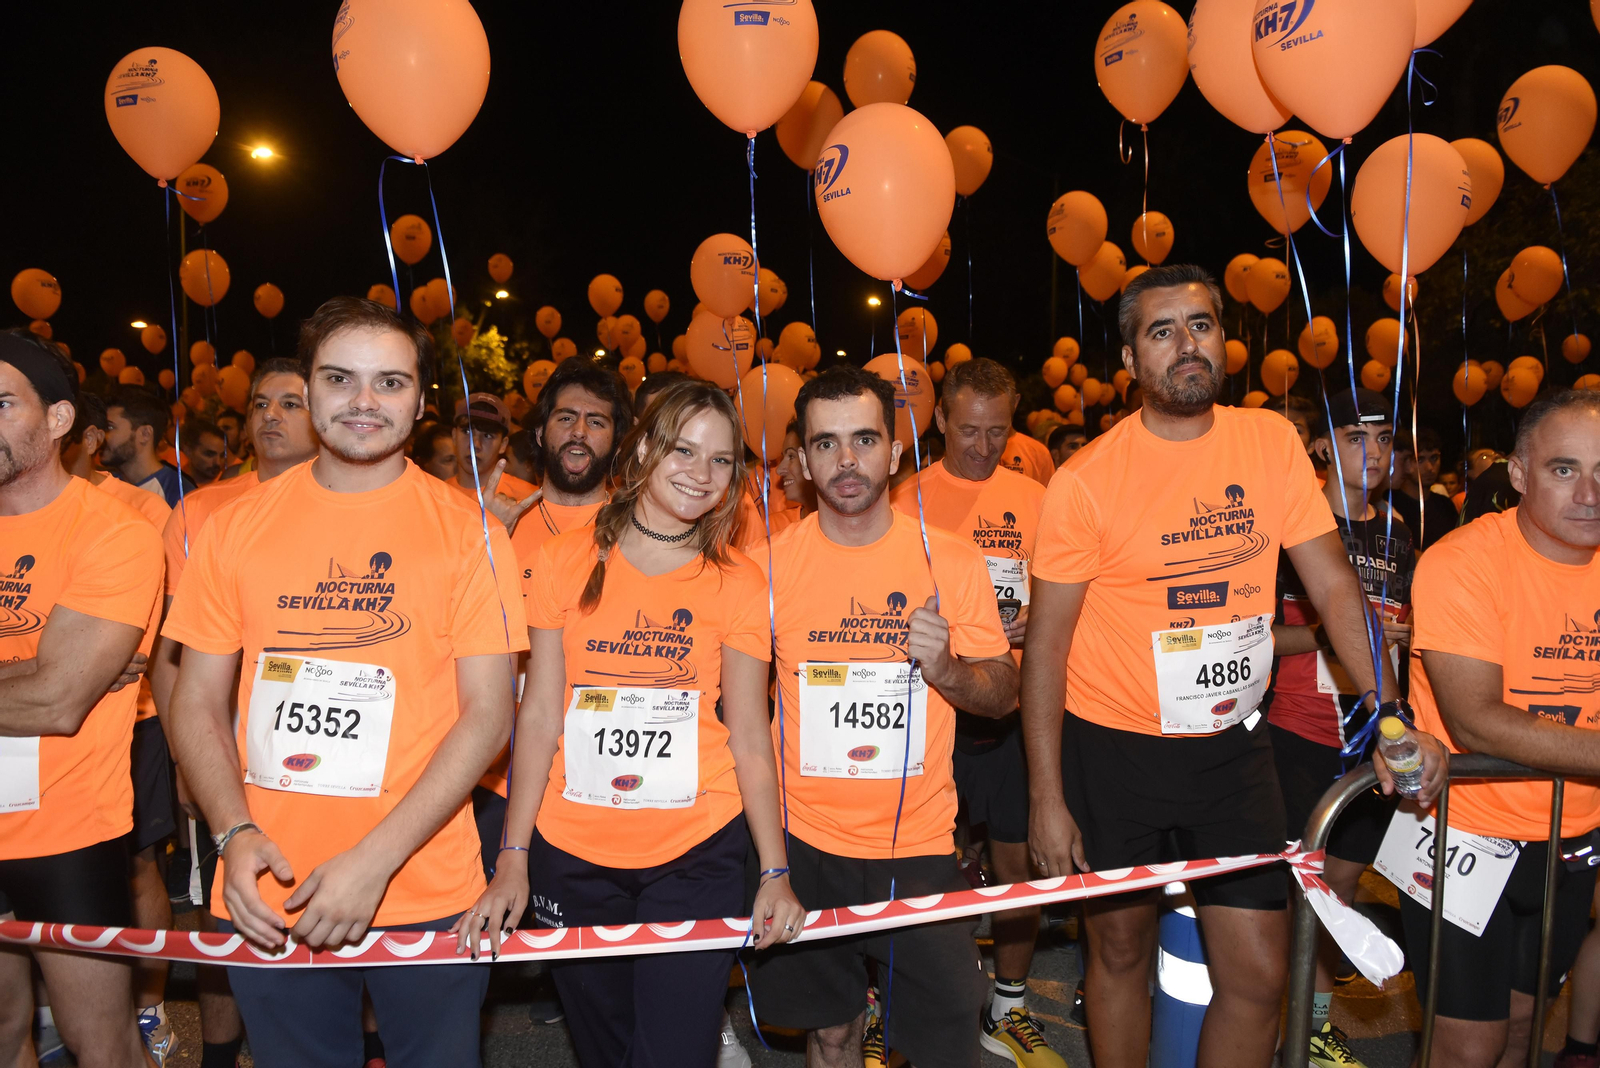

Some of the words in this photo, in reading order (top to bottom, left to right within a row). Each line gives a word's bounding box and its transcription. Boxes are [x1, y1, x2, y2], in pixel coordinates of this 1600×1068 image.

[1280, 30, 1324, 51] SEVILLA
[823, 187, 851, 203] SEVILLA
[1190, 508, 1255, 527] NOCTURNA
[973, 530, 1023, 539] NOCTURNA
[1161, 525, 1224, 546] SEVILLA
[1356, 555, 1397, 573] PABLO
[315, 581, 395, 594] NOCTURNA
[277, 595, 349, 610] SEVILLA
[622, 630, 693, 647] NOCTURNA
[807, 631, 871, 643] SEVILLA
[585, 639, 652, 657] SEVILLA
[354, 676, 386, 685] NOCTURNA
[1196, 656, 1251, 688] 4886
[340, 680, 367, 690] SEVILLA
[1176, 693, 1204, 701] FRANCISCO
[1205, 690, 1222, 698] JAVIER
[1223, 684, 1247, 696] CABANILLAS
[274, 700, 361, 740] 15352
[830, 702, 905, 730] 14582
[594, 728, 672, 758] 13972
[532, 894, 563, 917] B.V.M.
